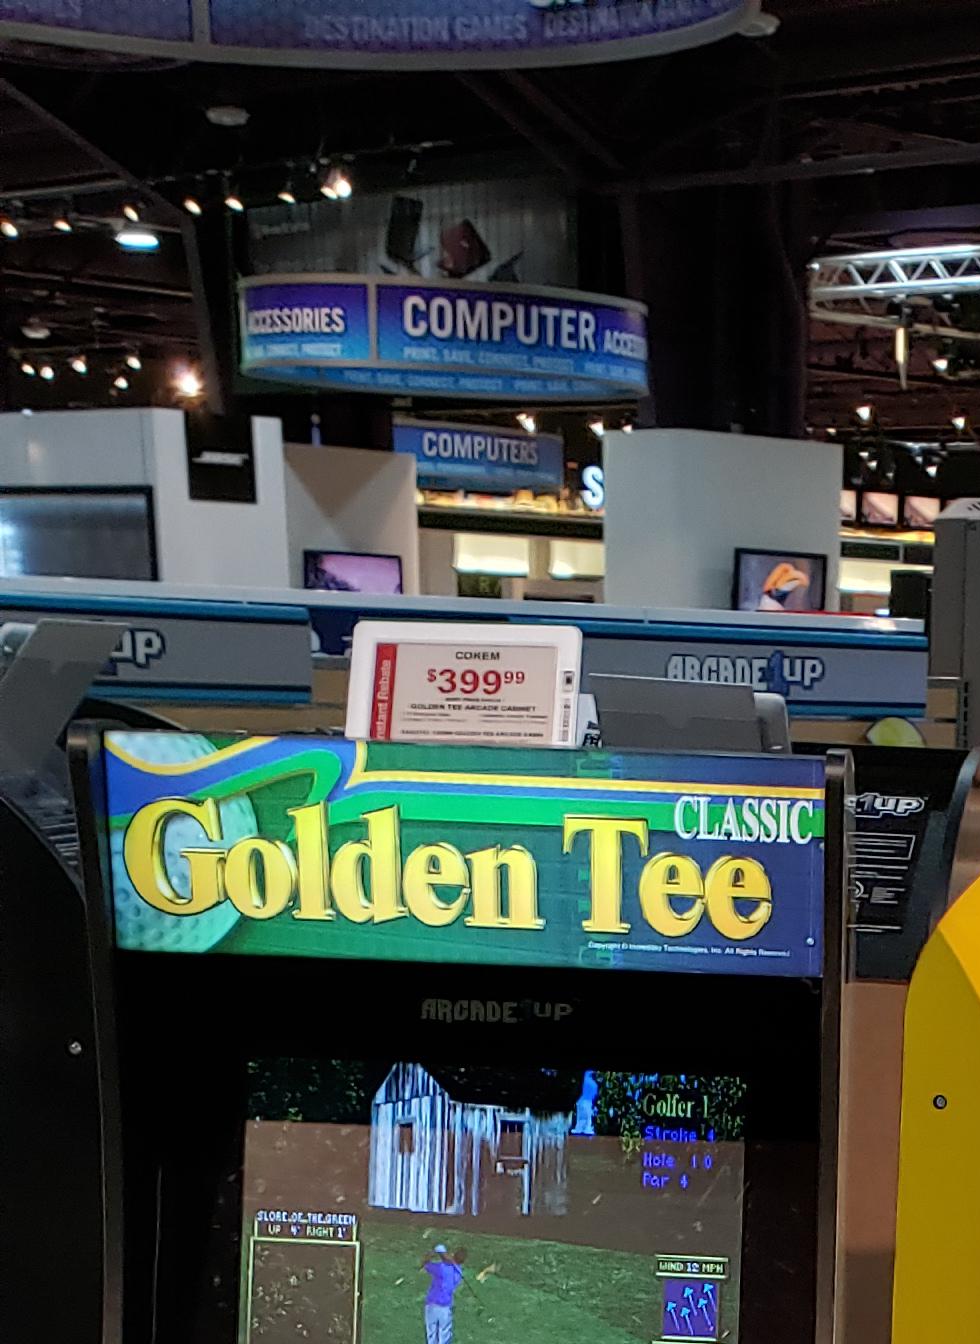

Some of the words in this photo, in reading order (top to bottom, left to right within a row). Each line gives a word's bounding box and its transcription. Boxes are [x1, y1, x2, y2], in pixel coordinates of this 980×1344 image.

[403, 295, 597, 352] COMPUTER
[422, 431, 538, 465] COMPUTERS
[455, 651, 501, 661] COKEM
[674, 795, 814, 845] CLASSIC
[123, 797, 546, 930] Golden
[562, 813, 773, 941] Tee
[643, 1092, 696, 1118] Golfer
[644, 1125, 698, 1142] Stroke
[643, 1152, 675, 1168] Hole
[642, 1172, 670, 1188] Par
[306, 1226, 335, 1238] RIGHT
[659, 1261, 684, 1272] WIND
[702, 1263, 724, 1274] MPH
